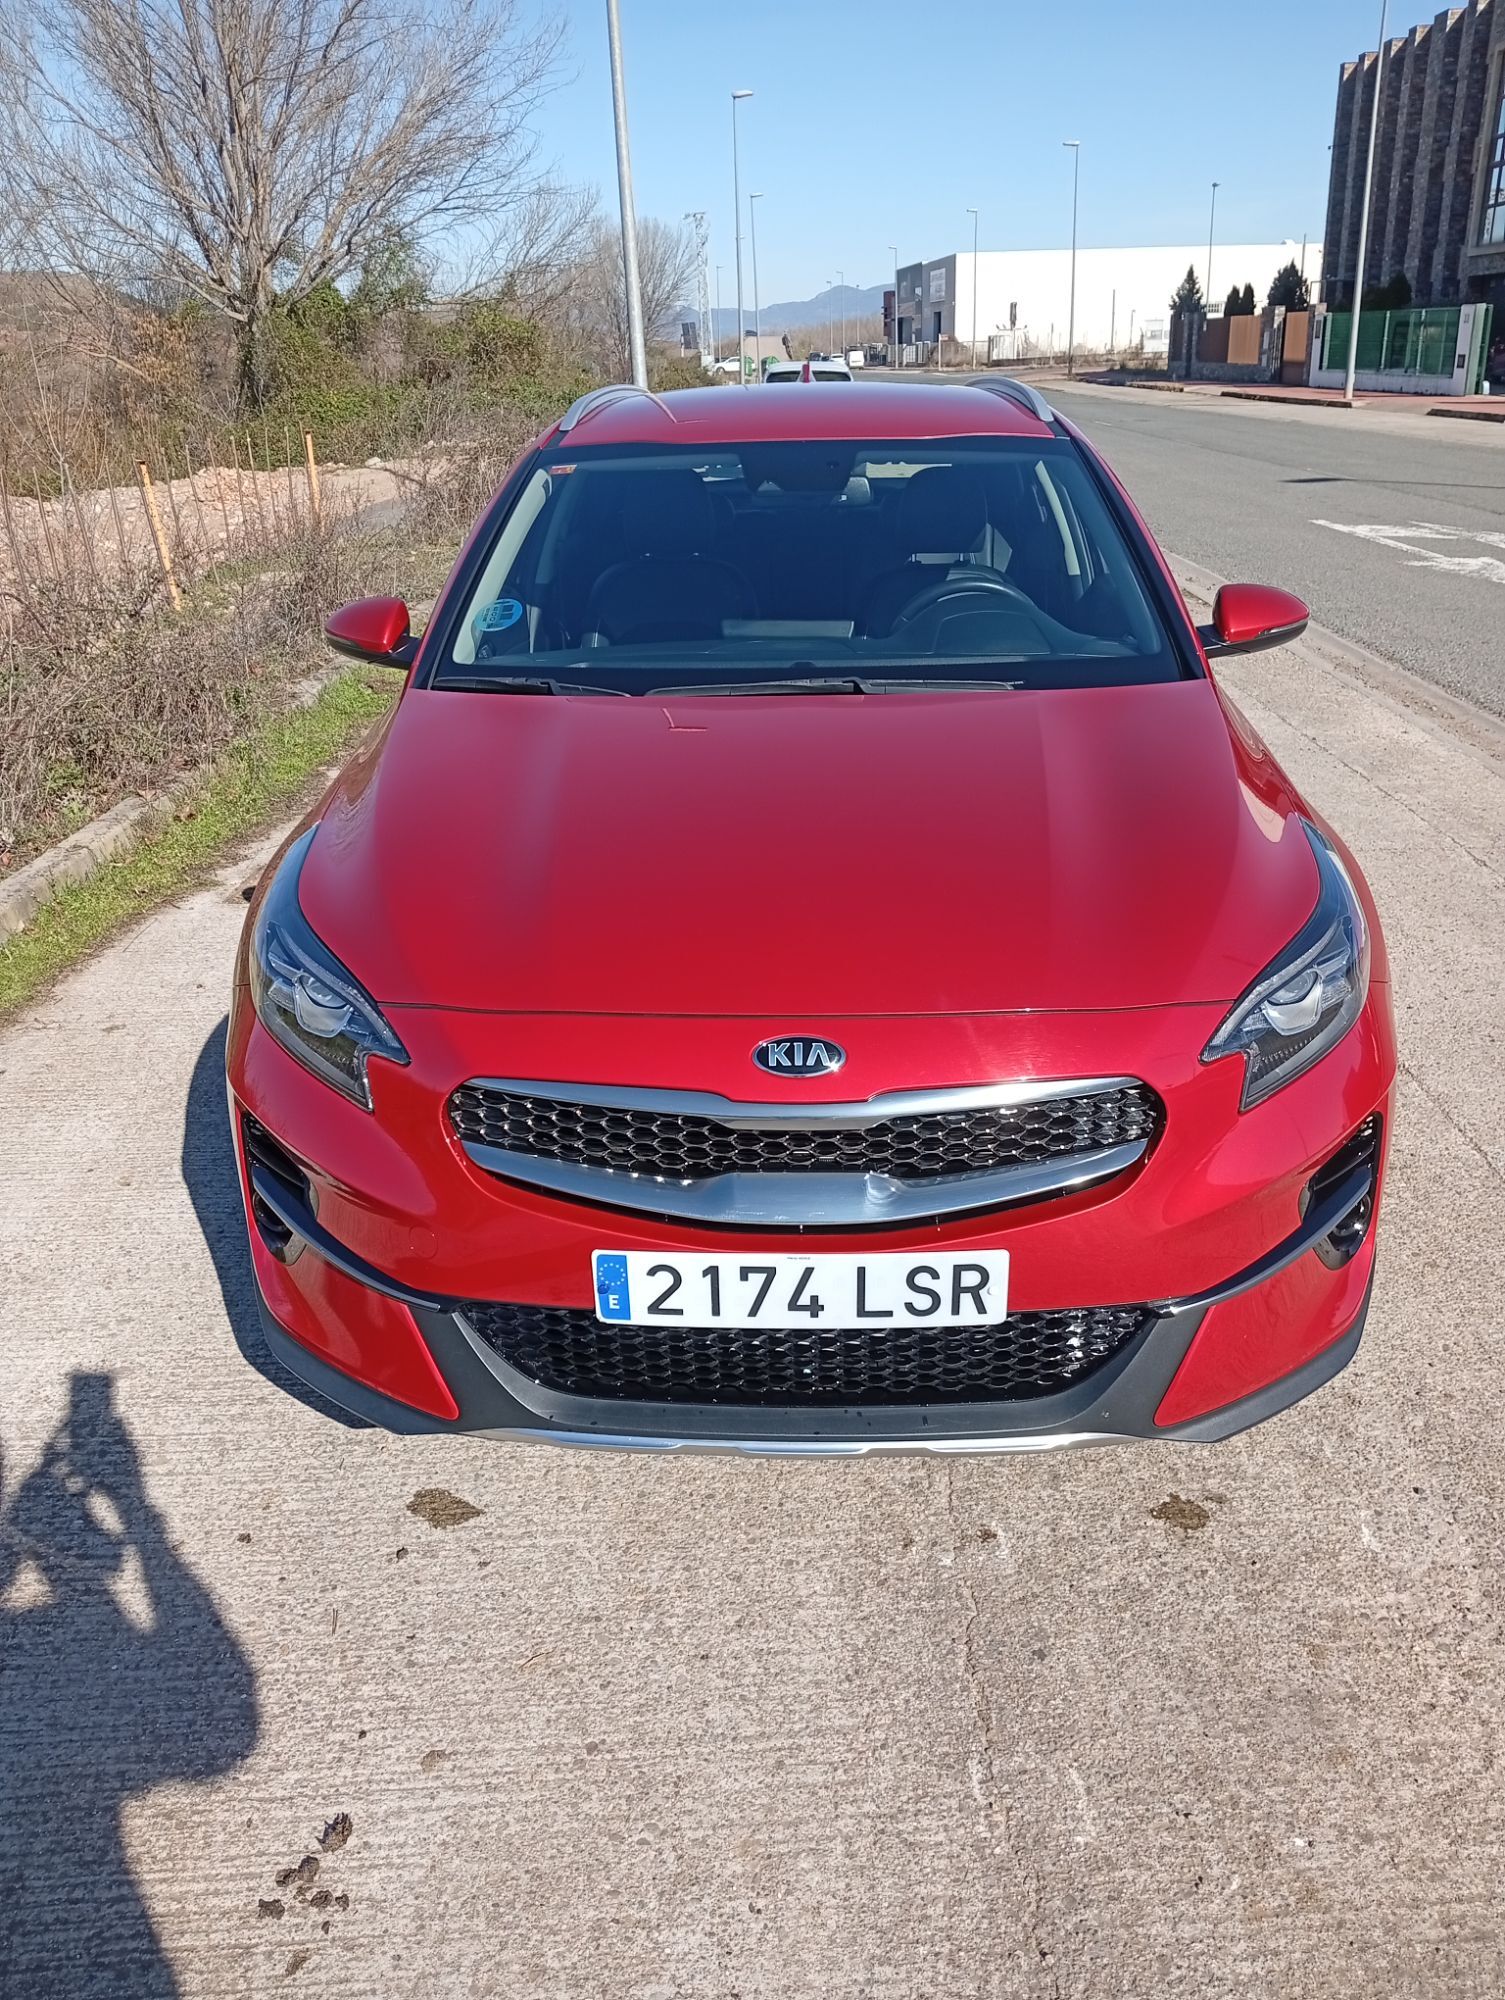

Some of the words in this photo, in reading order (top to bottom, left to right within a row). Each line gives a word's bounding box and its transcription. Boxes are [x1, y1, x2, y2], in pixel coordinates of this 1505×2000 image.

[767, 1042, 830, 1067] KIA
[608, 1295, 619, 1310] E
[646, 1264, 825, 1318] 2174
[856, 1263, 991, 1318] LSR
